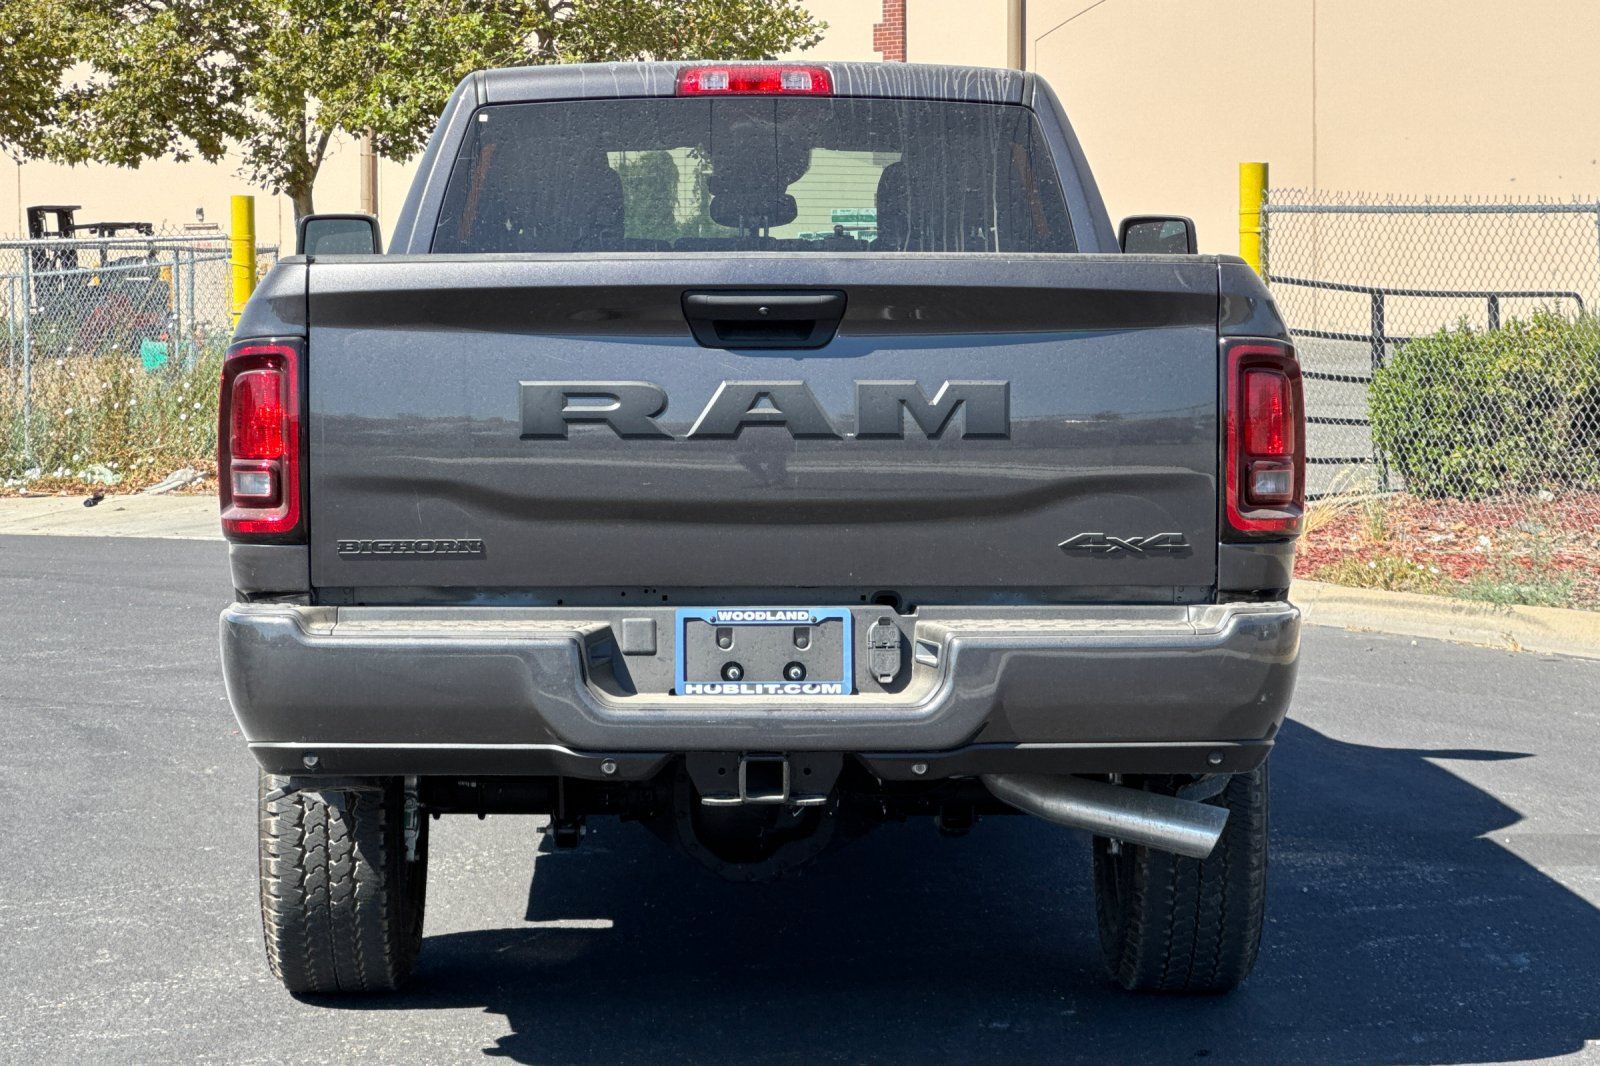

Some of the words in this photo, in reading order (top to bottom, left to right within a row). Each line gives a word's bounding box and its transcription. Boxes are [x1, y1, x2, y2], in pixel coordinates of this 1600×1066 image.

[519, 379, 1011, 440] RAM
[336, 538, 484, 555] BIGHORN
[717, 610, 809, 621] WOODLAND
